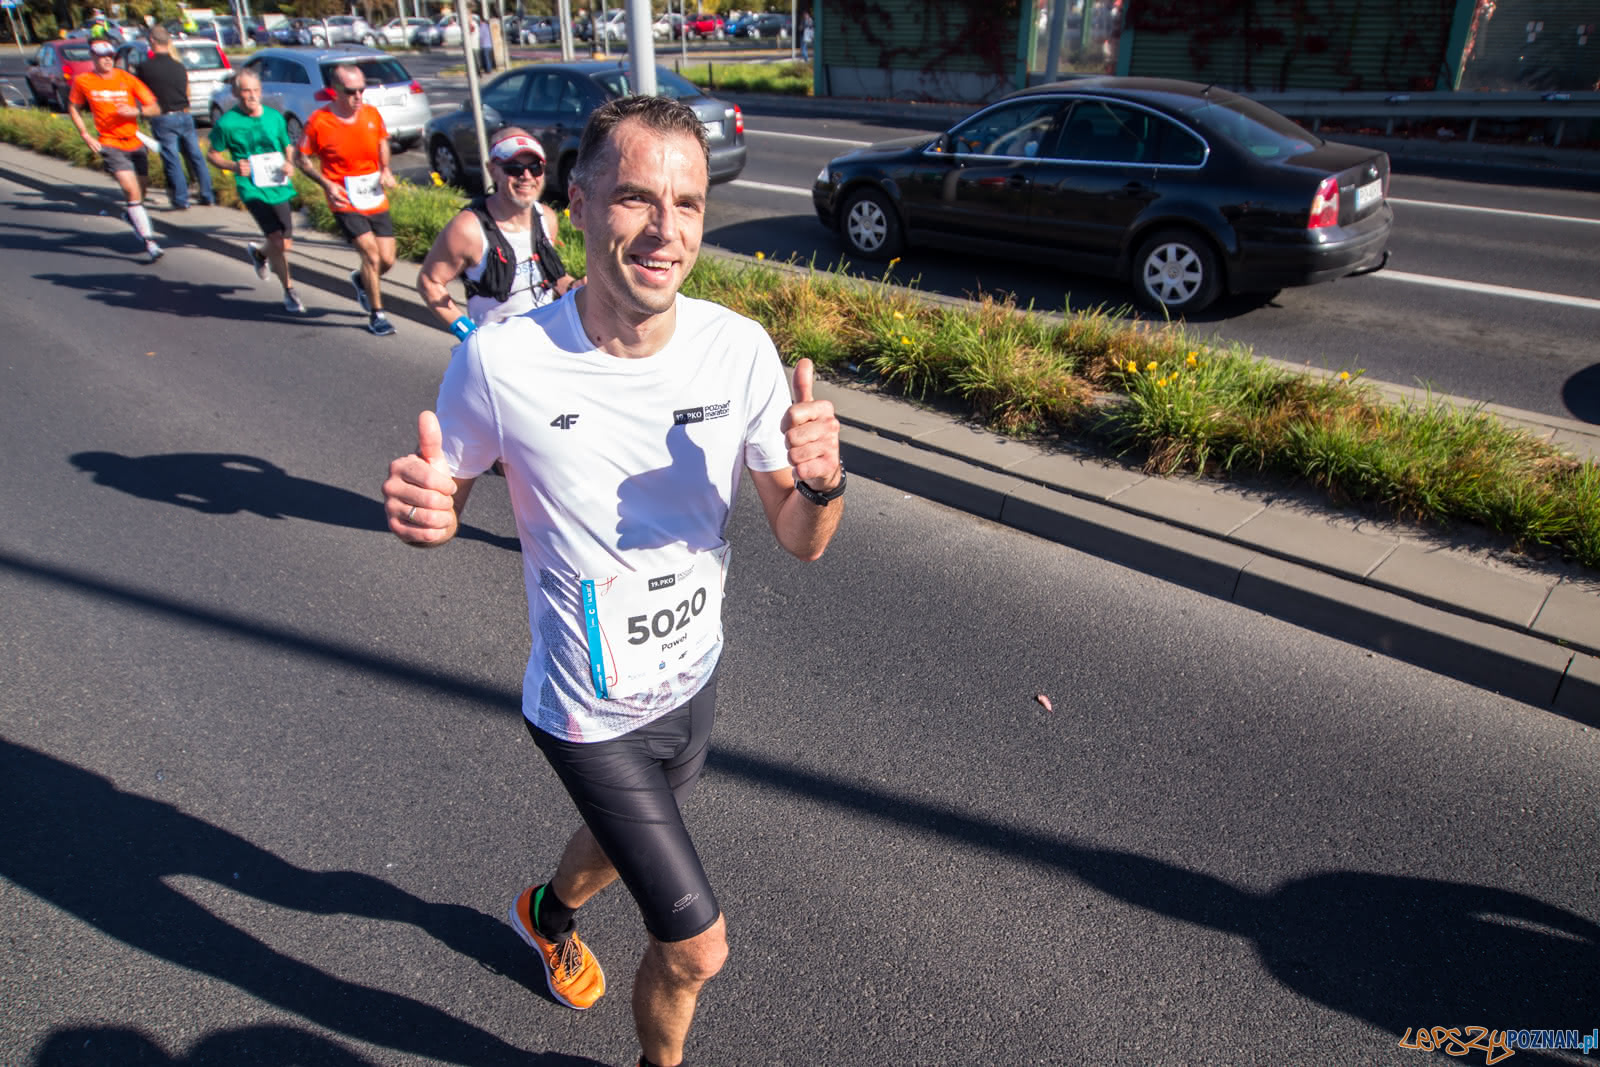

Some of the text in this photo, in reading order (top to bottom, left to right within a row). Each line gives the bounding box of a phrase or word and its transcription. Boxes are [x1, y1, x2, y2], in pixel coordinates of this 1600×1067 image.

[549, 413, 580, 430] 4F
[686, 411, 702, 420] PKO
[659, 577, 674, 586] PKO
[627, 586, 707, 646] 5020
